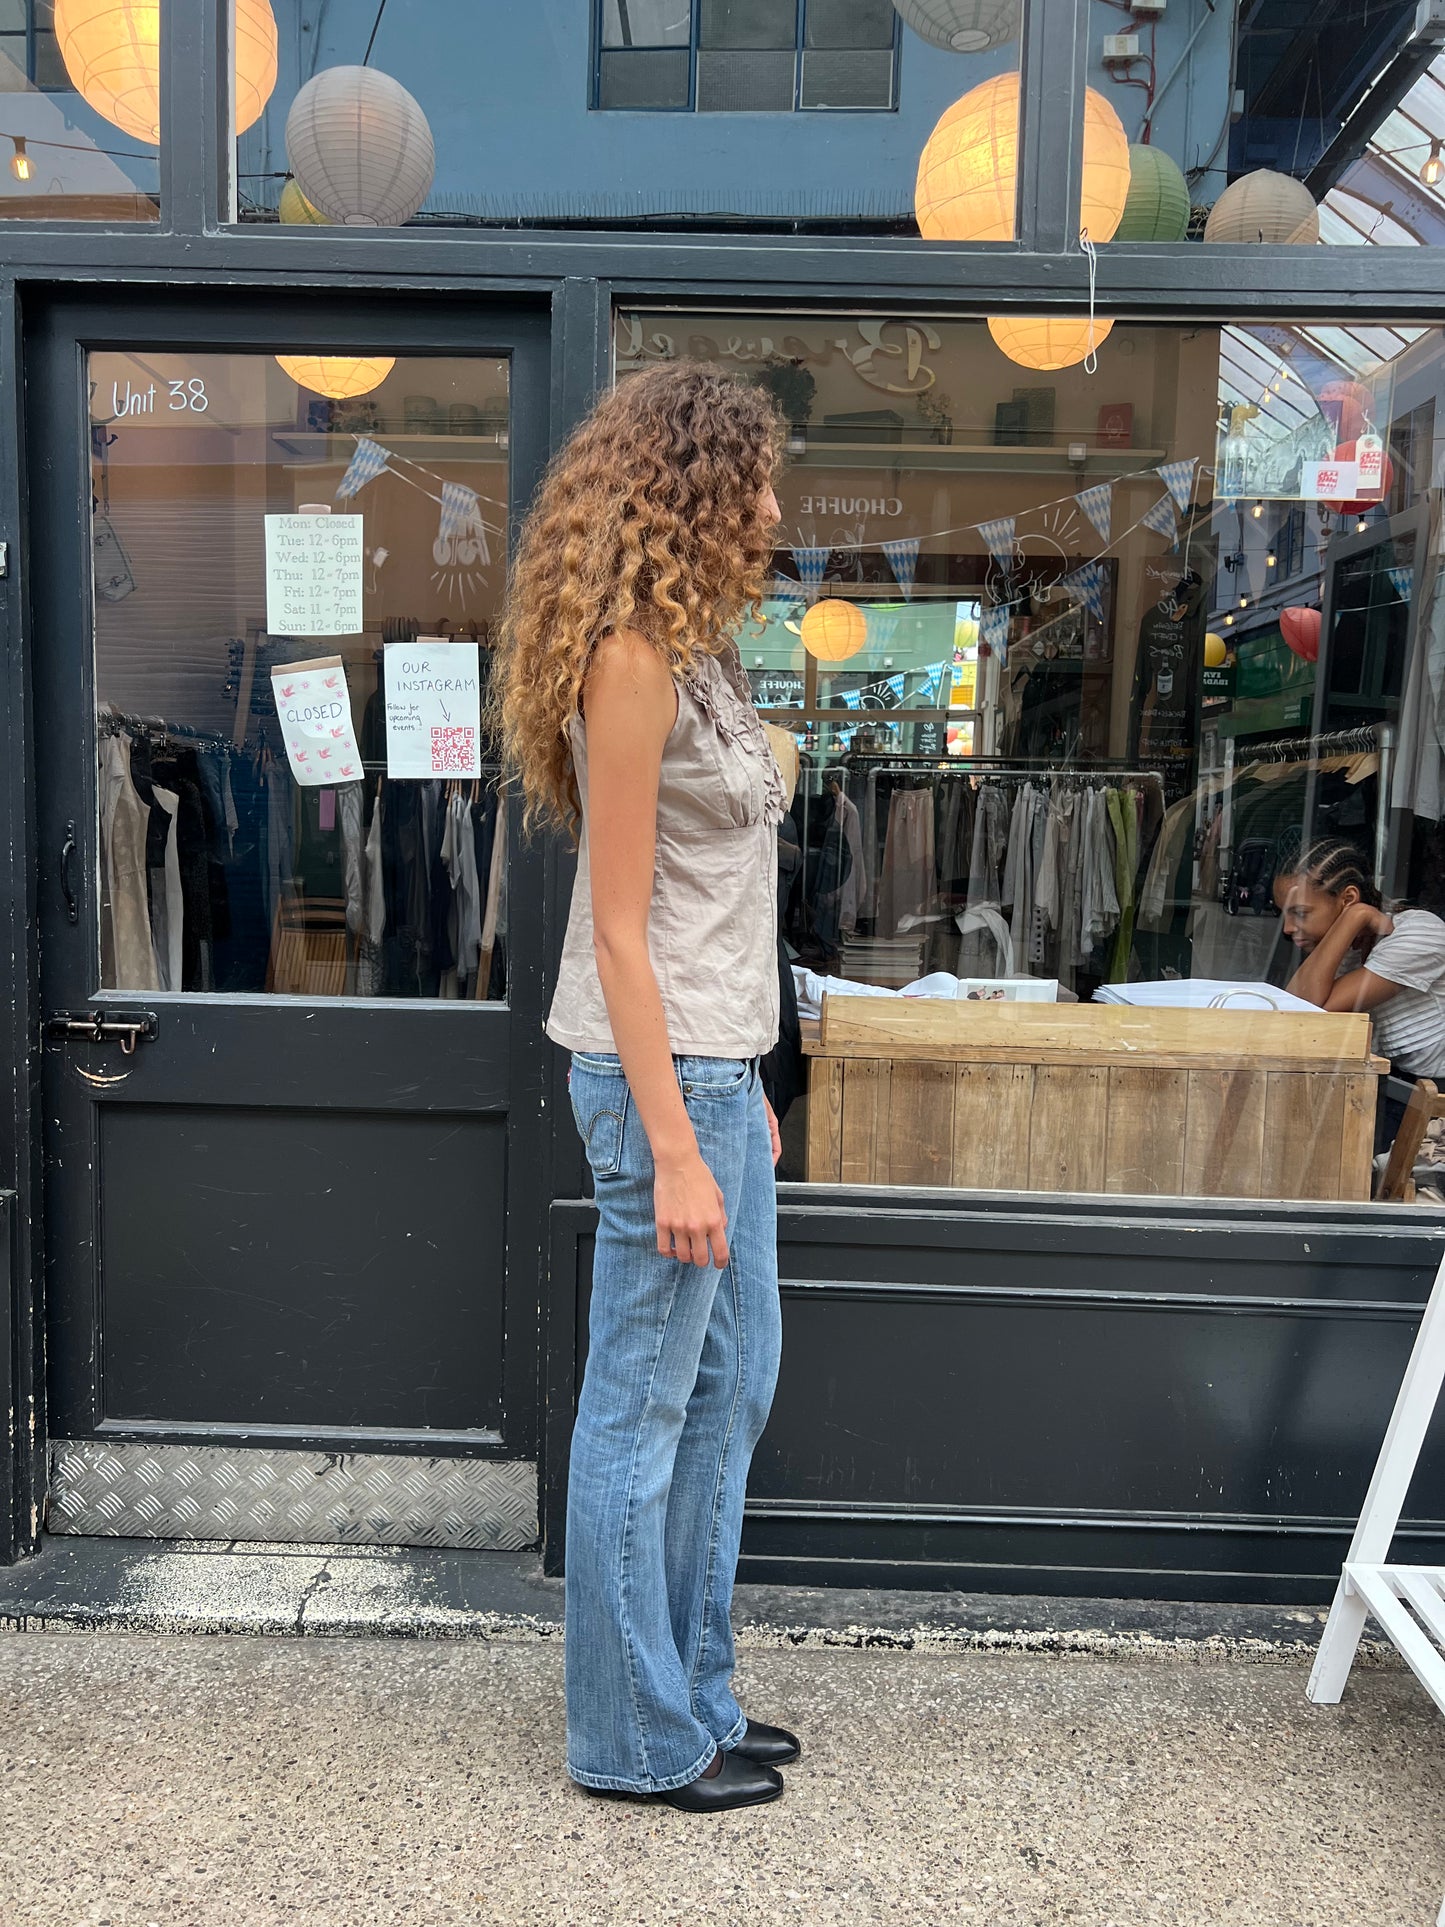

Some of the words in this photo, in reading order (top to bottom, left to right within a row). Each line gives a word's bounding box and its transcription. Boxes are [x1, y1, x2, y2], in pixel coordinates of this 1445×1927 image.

[113, 381, 157, 417] Unit
[168, 378, 209, 412] 38
[279, 517, 311, 529] Mon:
[315, 517, 355, 529] Closed
[277, 534, 305, 546] Tue:
[309, 533, 323, 546] 12
[332, 534, 359, 549] 6pm
[275, 551, 309, 563] Wed:
[313, 551, 326, 564] 12
[335, 552, 361, 566] 6pm
[273, 568, 303, 581] Thu:
[312, 567, 325, 581] 12
[335, 568, 360, 583] 7pm
[284, 586, 305, 597] Fri:
[309, 585, 322, 598] 12
[332, 586, 357, 600] 7pm
[284, 603, 306, 615] Sat:
[310, 603, 321, 615] 11
[333, 603, 357, 617] 7pm
[278, 620, 306, 632] Sun:
[311, 619, 324, 632] 12
[334, 620, 358, 635] 6pm
[402, 661, 432, 674] OUR
[397, 678, 476, 692] INSTAGRAM
[286, 702, 343, 723] CLOSED
[389, 715, 423, 727] upcoming
